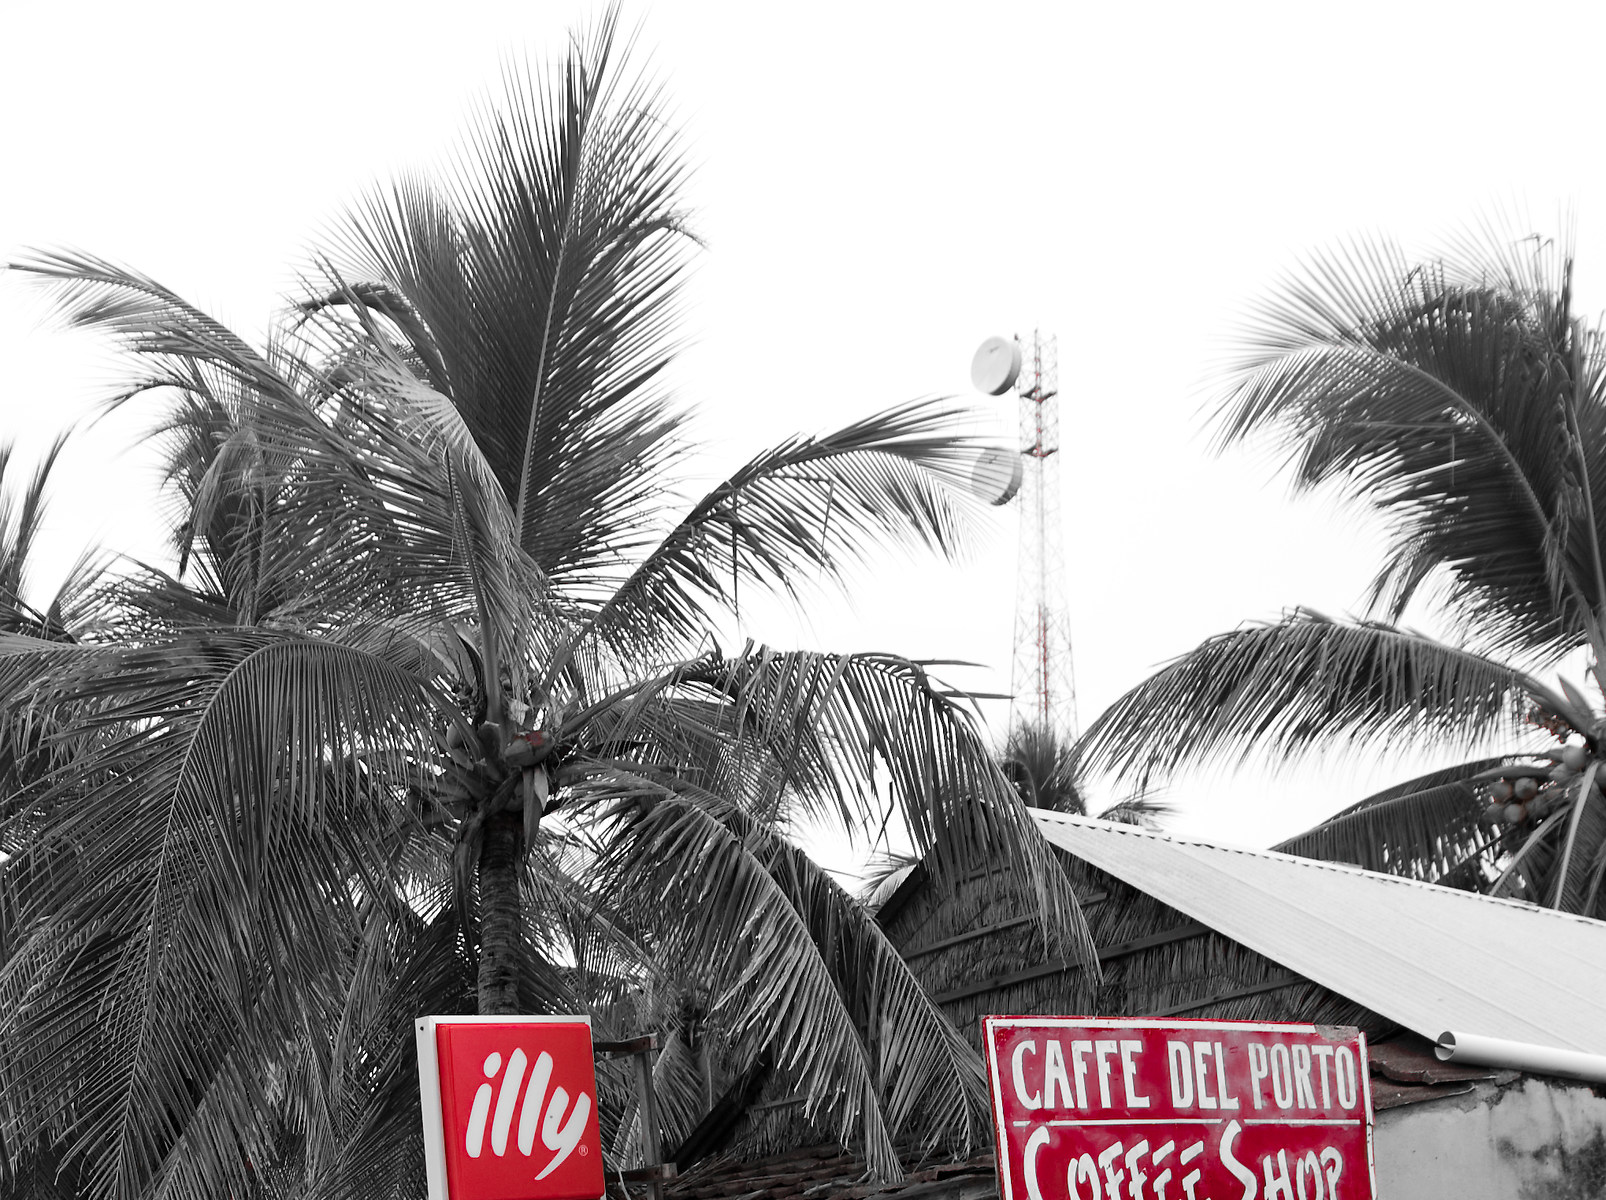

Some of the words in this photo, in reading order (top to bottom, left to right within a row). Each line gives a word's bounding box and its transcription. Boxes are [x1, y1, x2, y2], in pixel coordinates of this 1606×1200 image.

[465, 1047, 592, 1181] illy
[1011, 1039, 1150, 1110] CAFFE
[1167, 1040, 1239, 1110] DEL
[1248, 1042, 1357, 1110] PORTO
